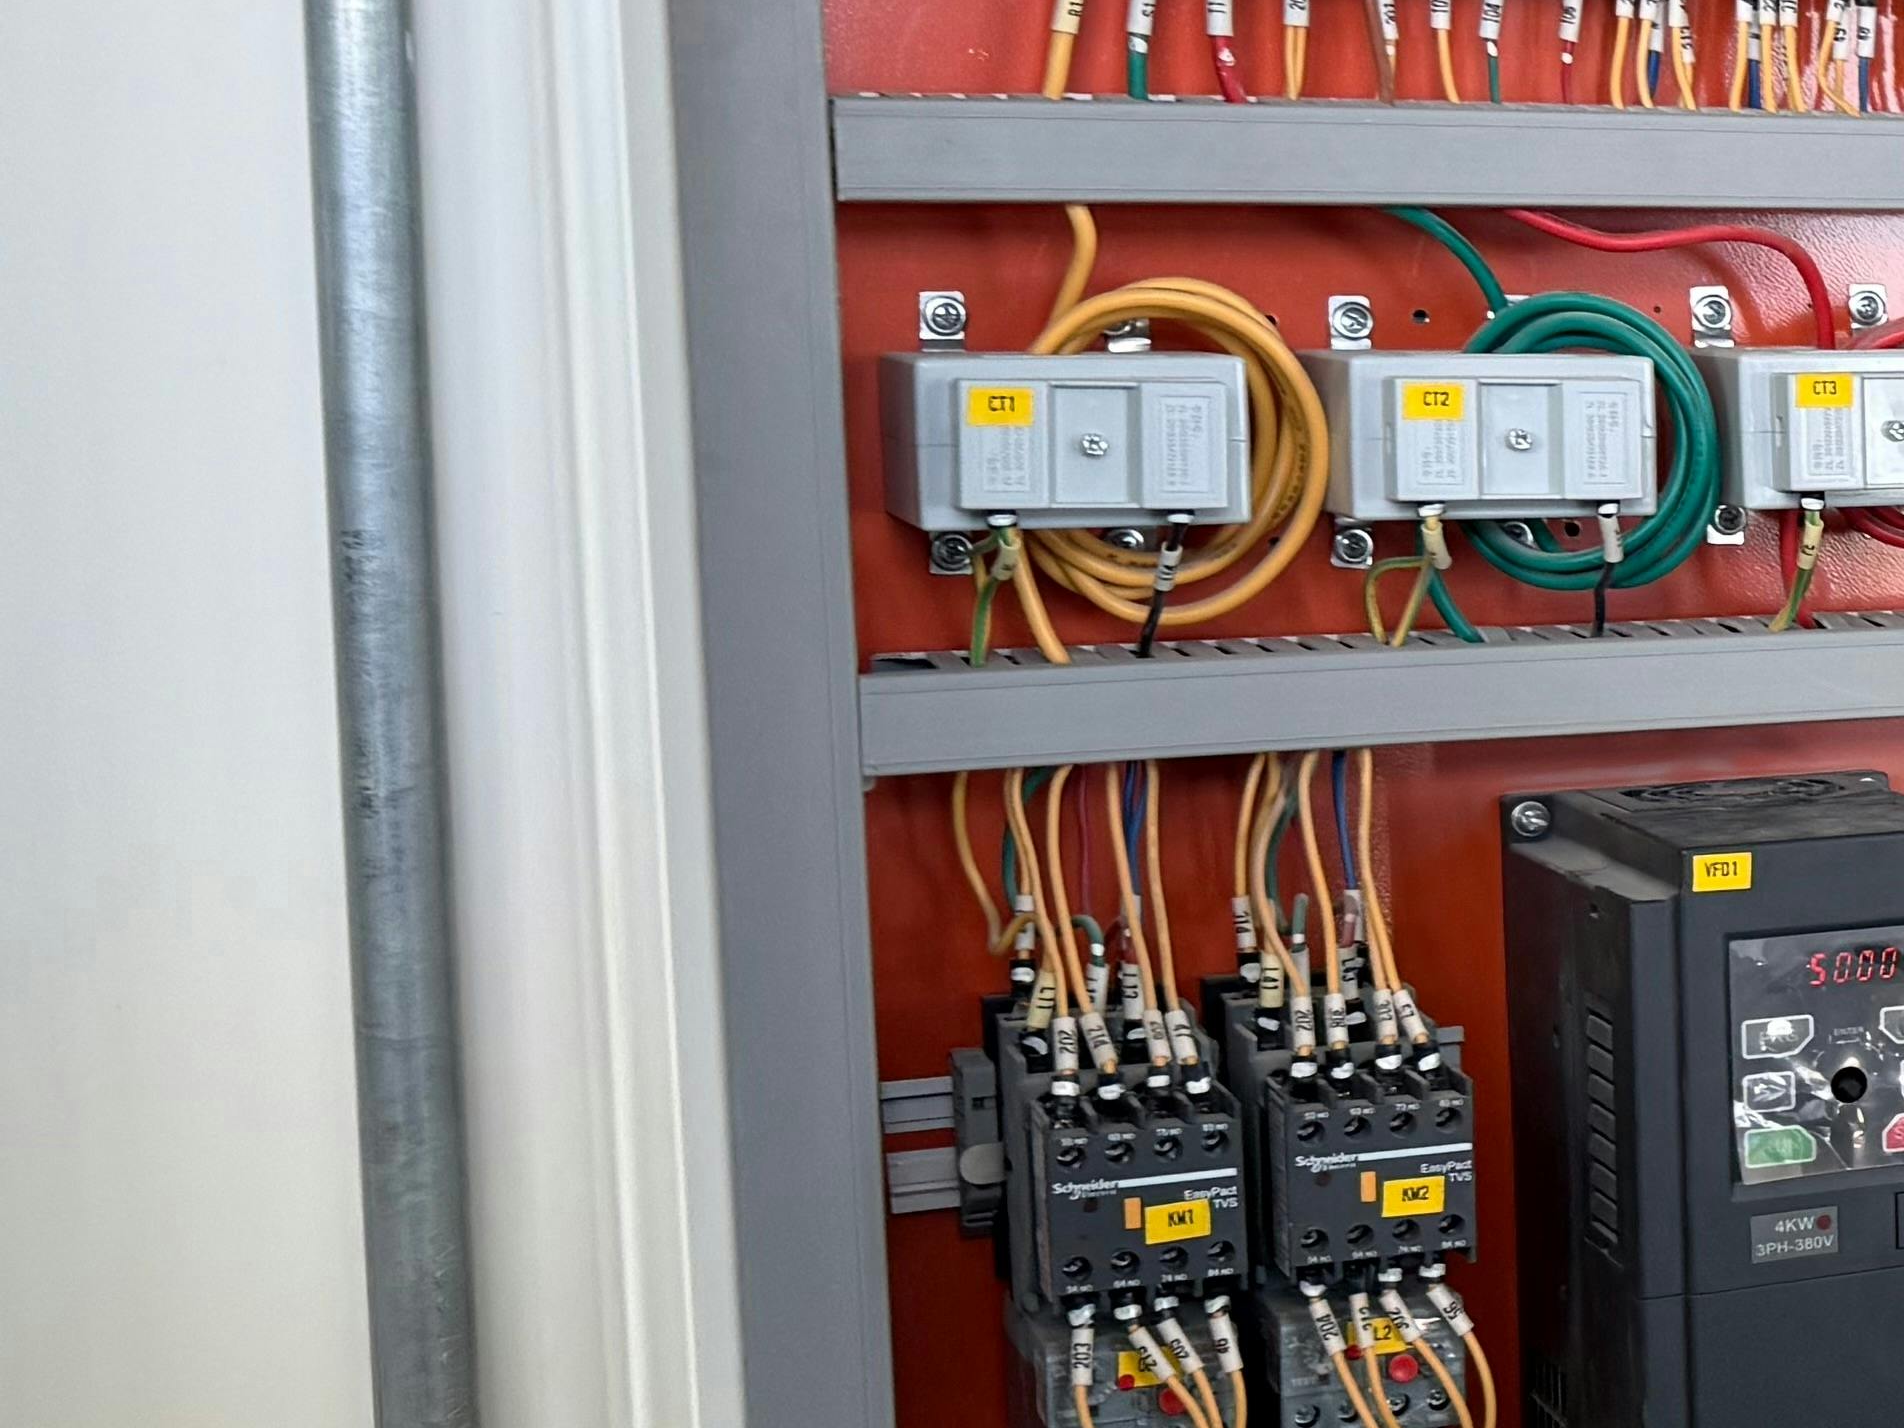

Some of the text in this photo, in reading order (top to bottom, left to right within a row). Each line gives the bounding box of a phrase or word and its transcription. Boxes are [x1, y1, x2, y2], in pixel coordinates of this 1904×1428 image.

[1812, 380, 1837, 396] CT3
[987, 395, 1016, 412] CT1
[1423, 391, 1450, 407] CT2
[1704, 862, 1738, 878] VFD1
[1809, 946, 1898, 987] 5000
[1294, 1009, 1312, 1032] 202
[1058, 1029, 1077, 1055] 202
[1295, 1151, 1359, 1173] Schneider
[1420, 1160, 1473, 1175] EasyPact
[1449, 1172, 1473, 1182] TVS
[1052, 1178, 1120, 1200] Schneider
[1183, 1185, 1238, 1201] EasyPact
[1212, 1197, 1239, 1209] TVS
[1168, 1209, 1194, 1227] KM1
[1774, 1216, 1815, 1234] 4KW
[1756, 1235, 1834, 1257] 3PH-380V
[1073, 1342, 1092, 1369] 203
